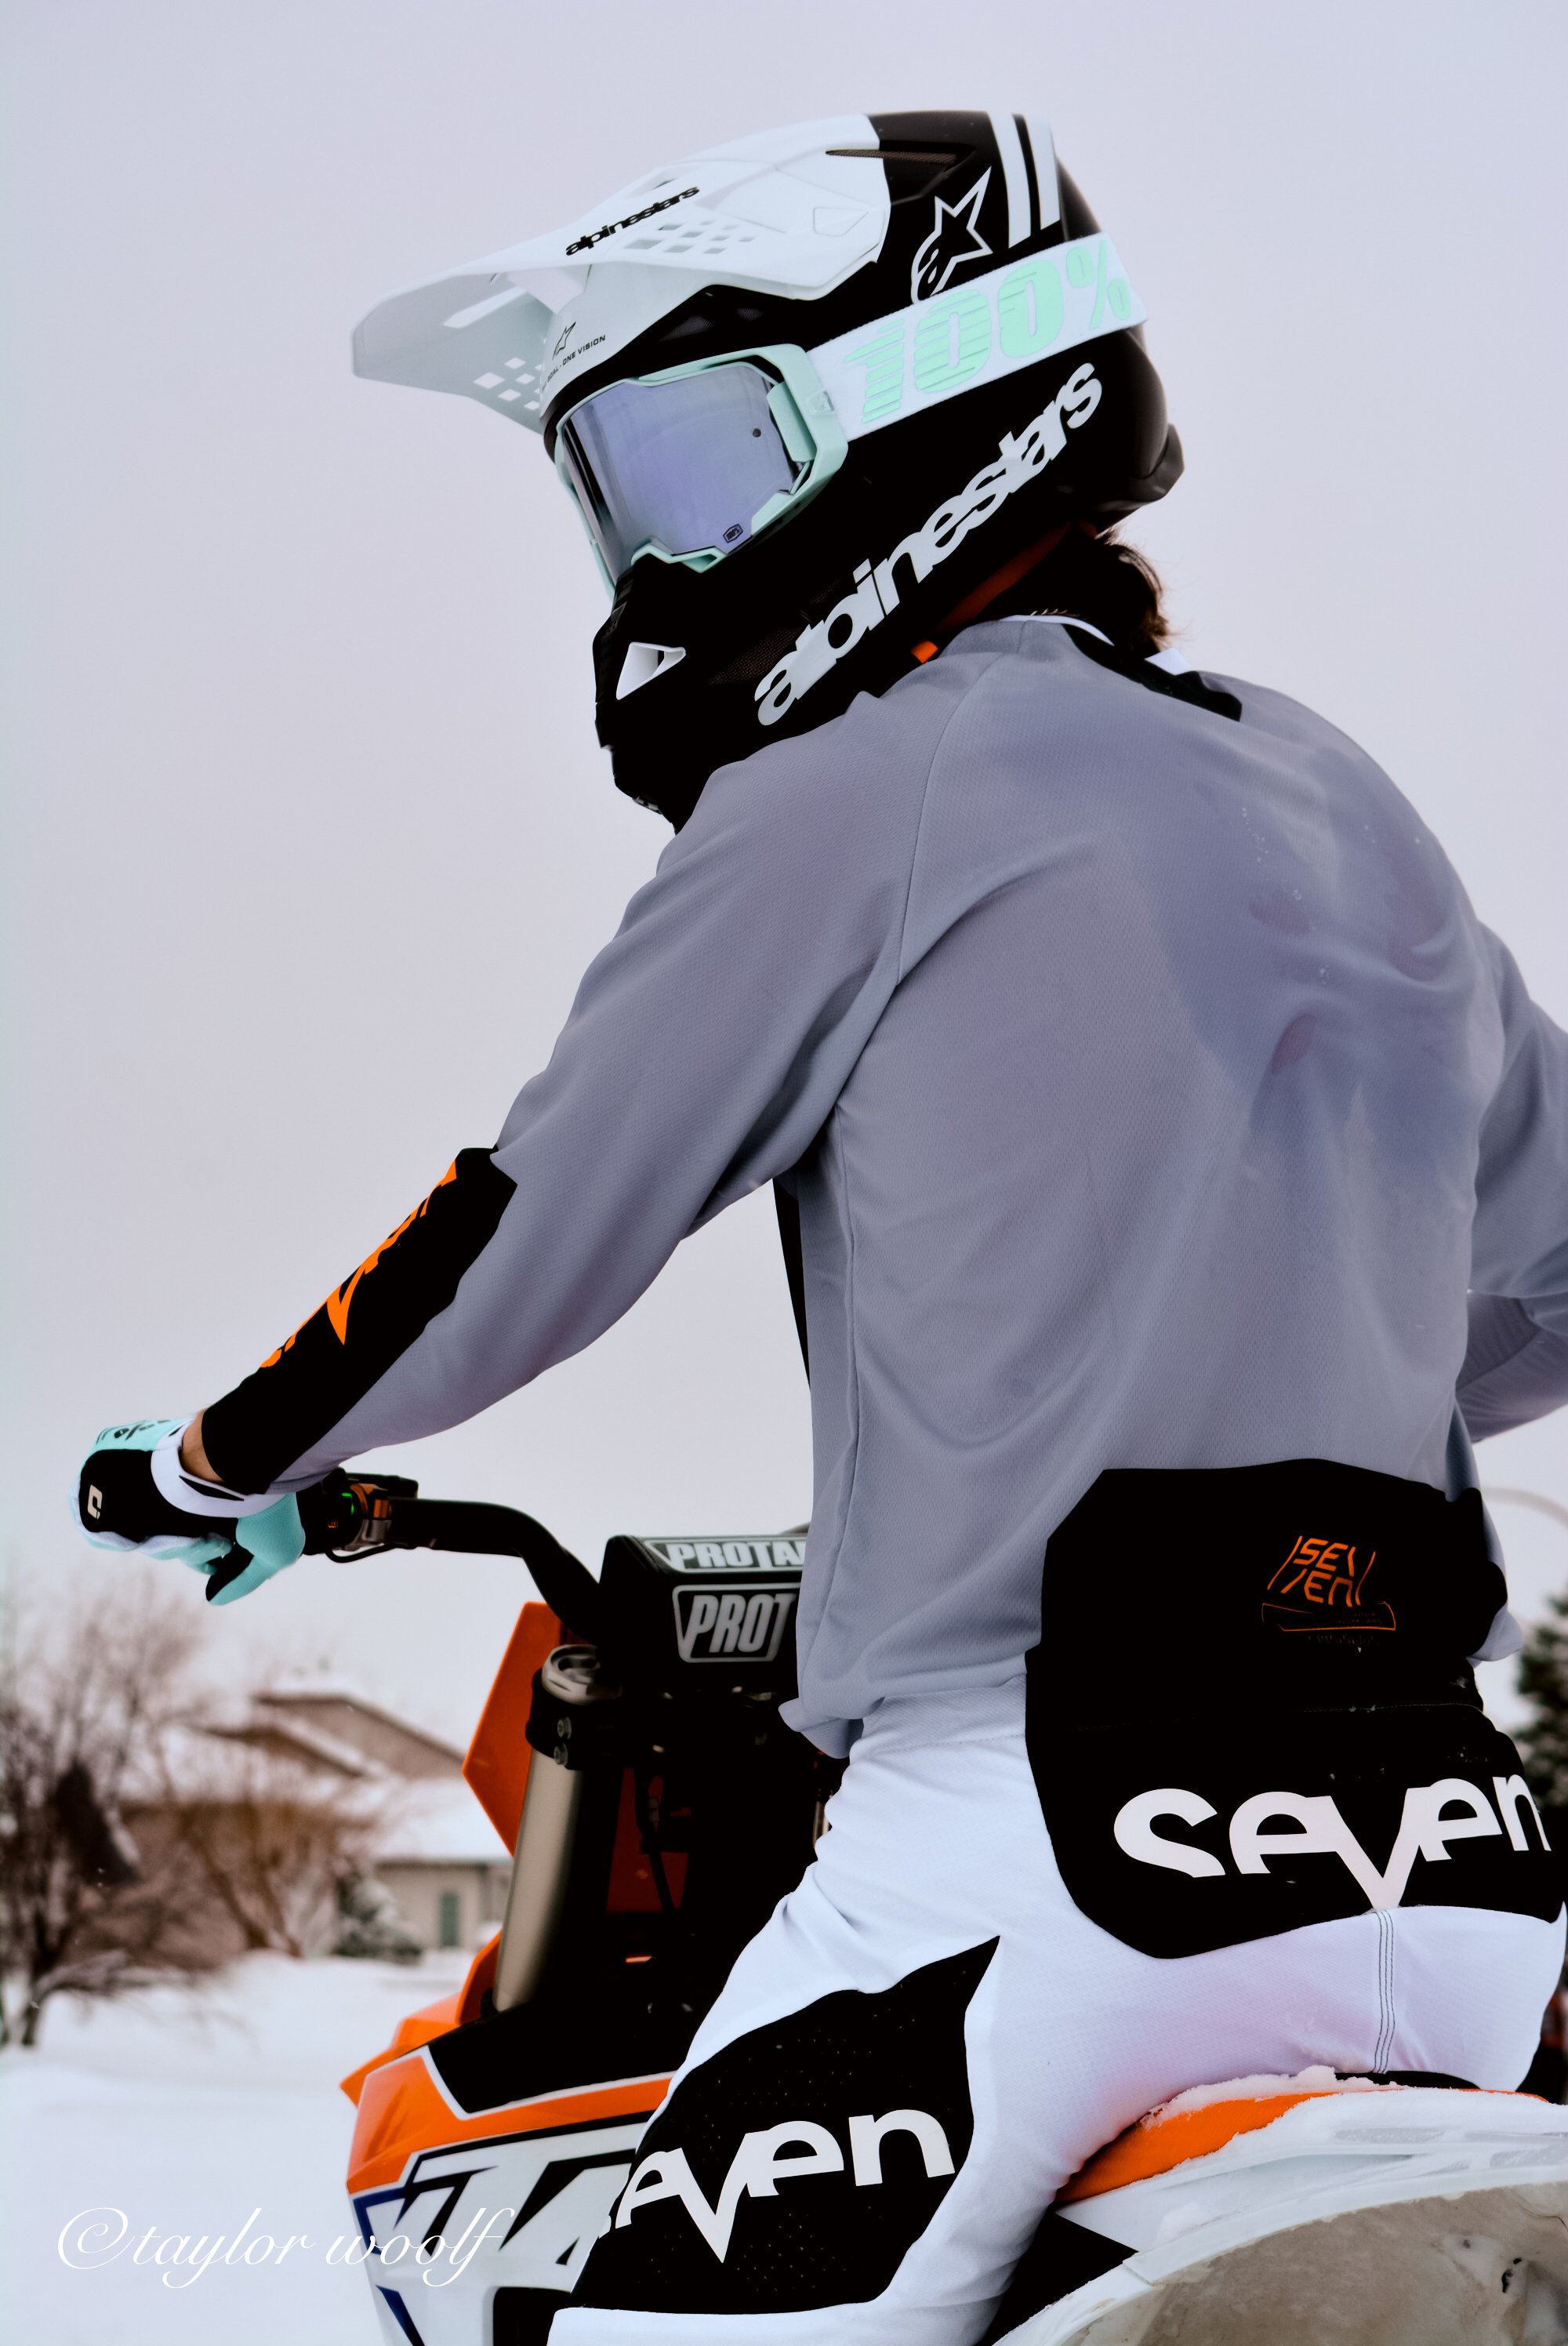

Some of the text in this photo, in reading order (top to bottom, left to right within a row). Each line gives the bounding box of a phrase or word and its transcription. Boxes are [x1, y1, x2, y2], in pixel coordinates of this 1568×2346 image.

[565, 187, 699, 256] alpinestars
[562, 351, 576, 365] ONE
[578, 334, 606, 354] VISION
[844, 241, 1132, 423] 100%
[754, 362, 1102, 726] alpinestars
